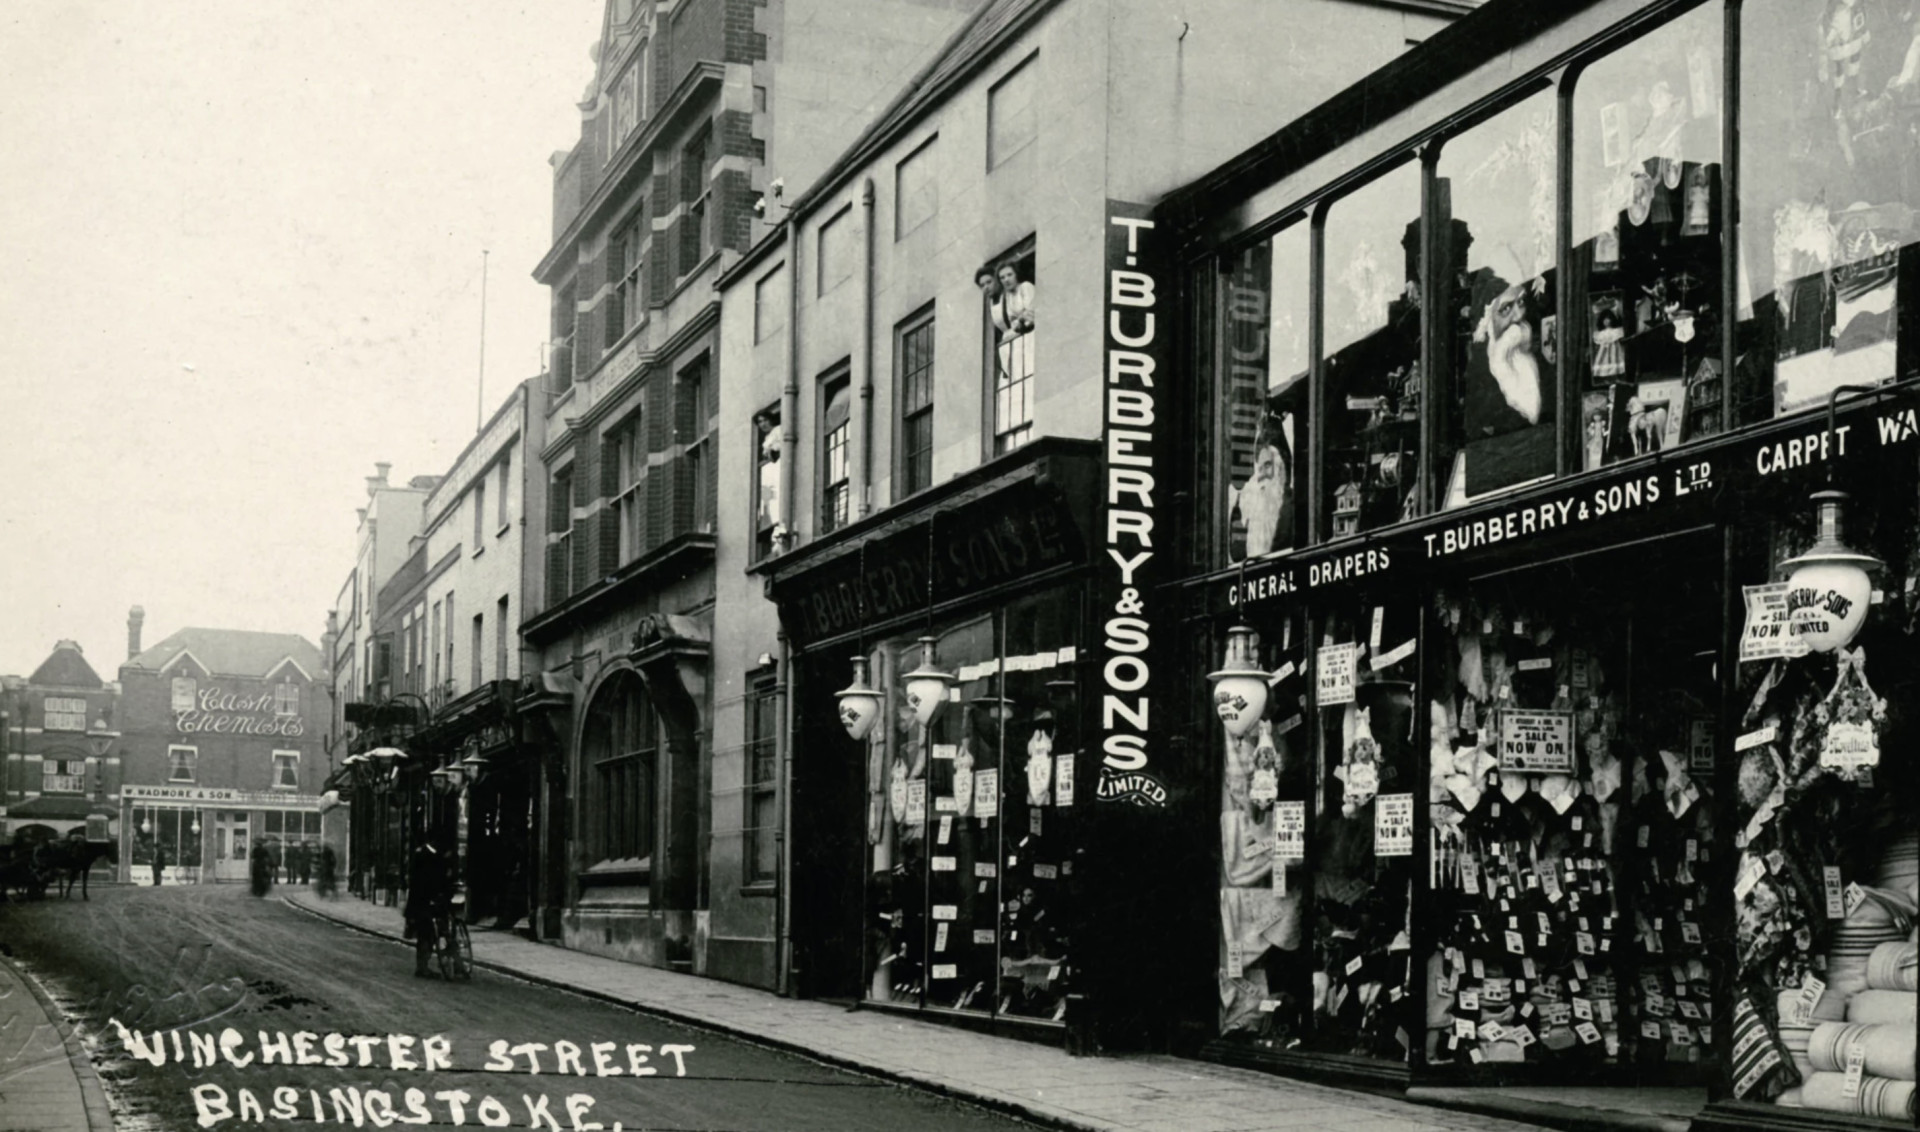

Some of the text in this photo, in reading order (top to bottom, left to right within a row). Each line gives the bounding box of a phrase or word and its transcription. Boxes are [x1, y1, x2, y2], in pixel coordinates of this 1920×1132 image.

[1757, 425, 1851, 475] CARPET
[1577, 501, 1589, 521] &
[1595, 475, 1661, 517] SONS
[1229, 547, 1391, 606] GNERAL DRAPERS
[1115, 587, 1144, 615] &
[1823, 589, 1853, 620] SONS
[1751, 624, 1783, 638] NOW
[198, 687, 277, 711] Cash
[1102, 617, 1150, 770] SONS
[176, 709, 303, 736] Chemists
[1506, 741, 1536, 754] NOW
[1525, 732, 1547, 742] SALE
[138, 788, 192, 799] WADMORE
